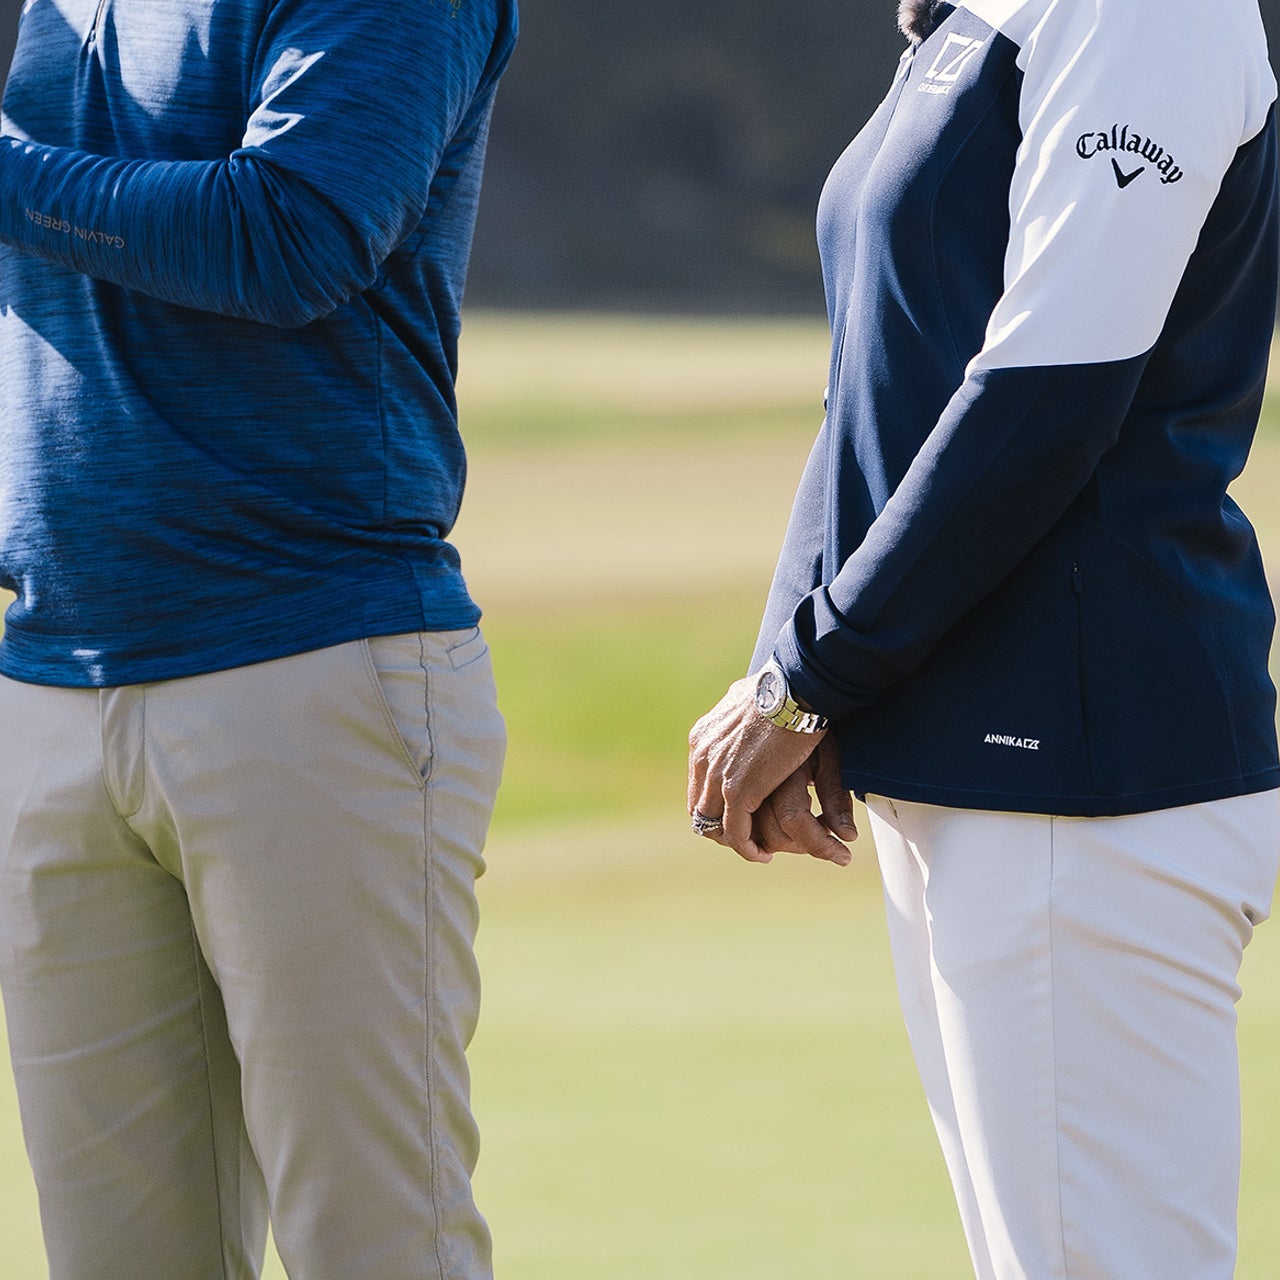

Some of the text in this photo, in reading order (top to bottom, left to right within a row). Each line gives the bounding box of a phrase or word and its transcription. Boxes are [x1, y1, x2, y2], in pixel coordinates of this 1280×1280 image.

[1075, 122, 1184, 185] Callaway
[25, 207, 126, 250] GALVIN GREEN
